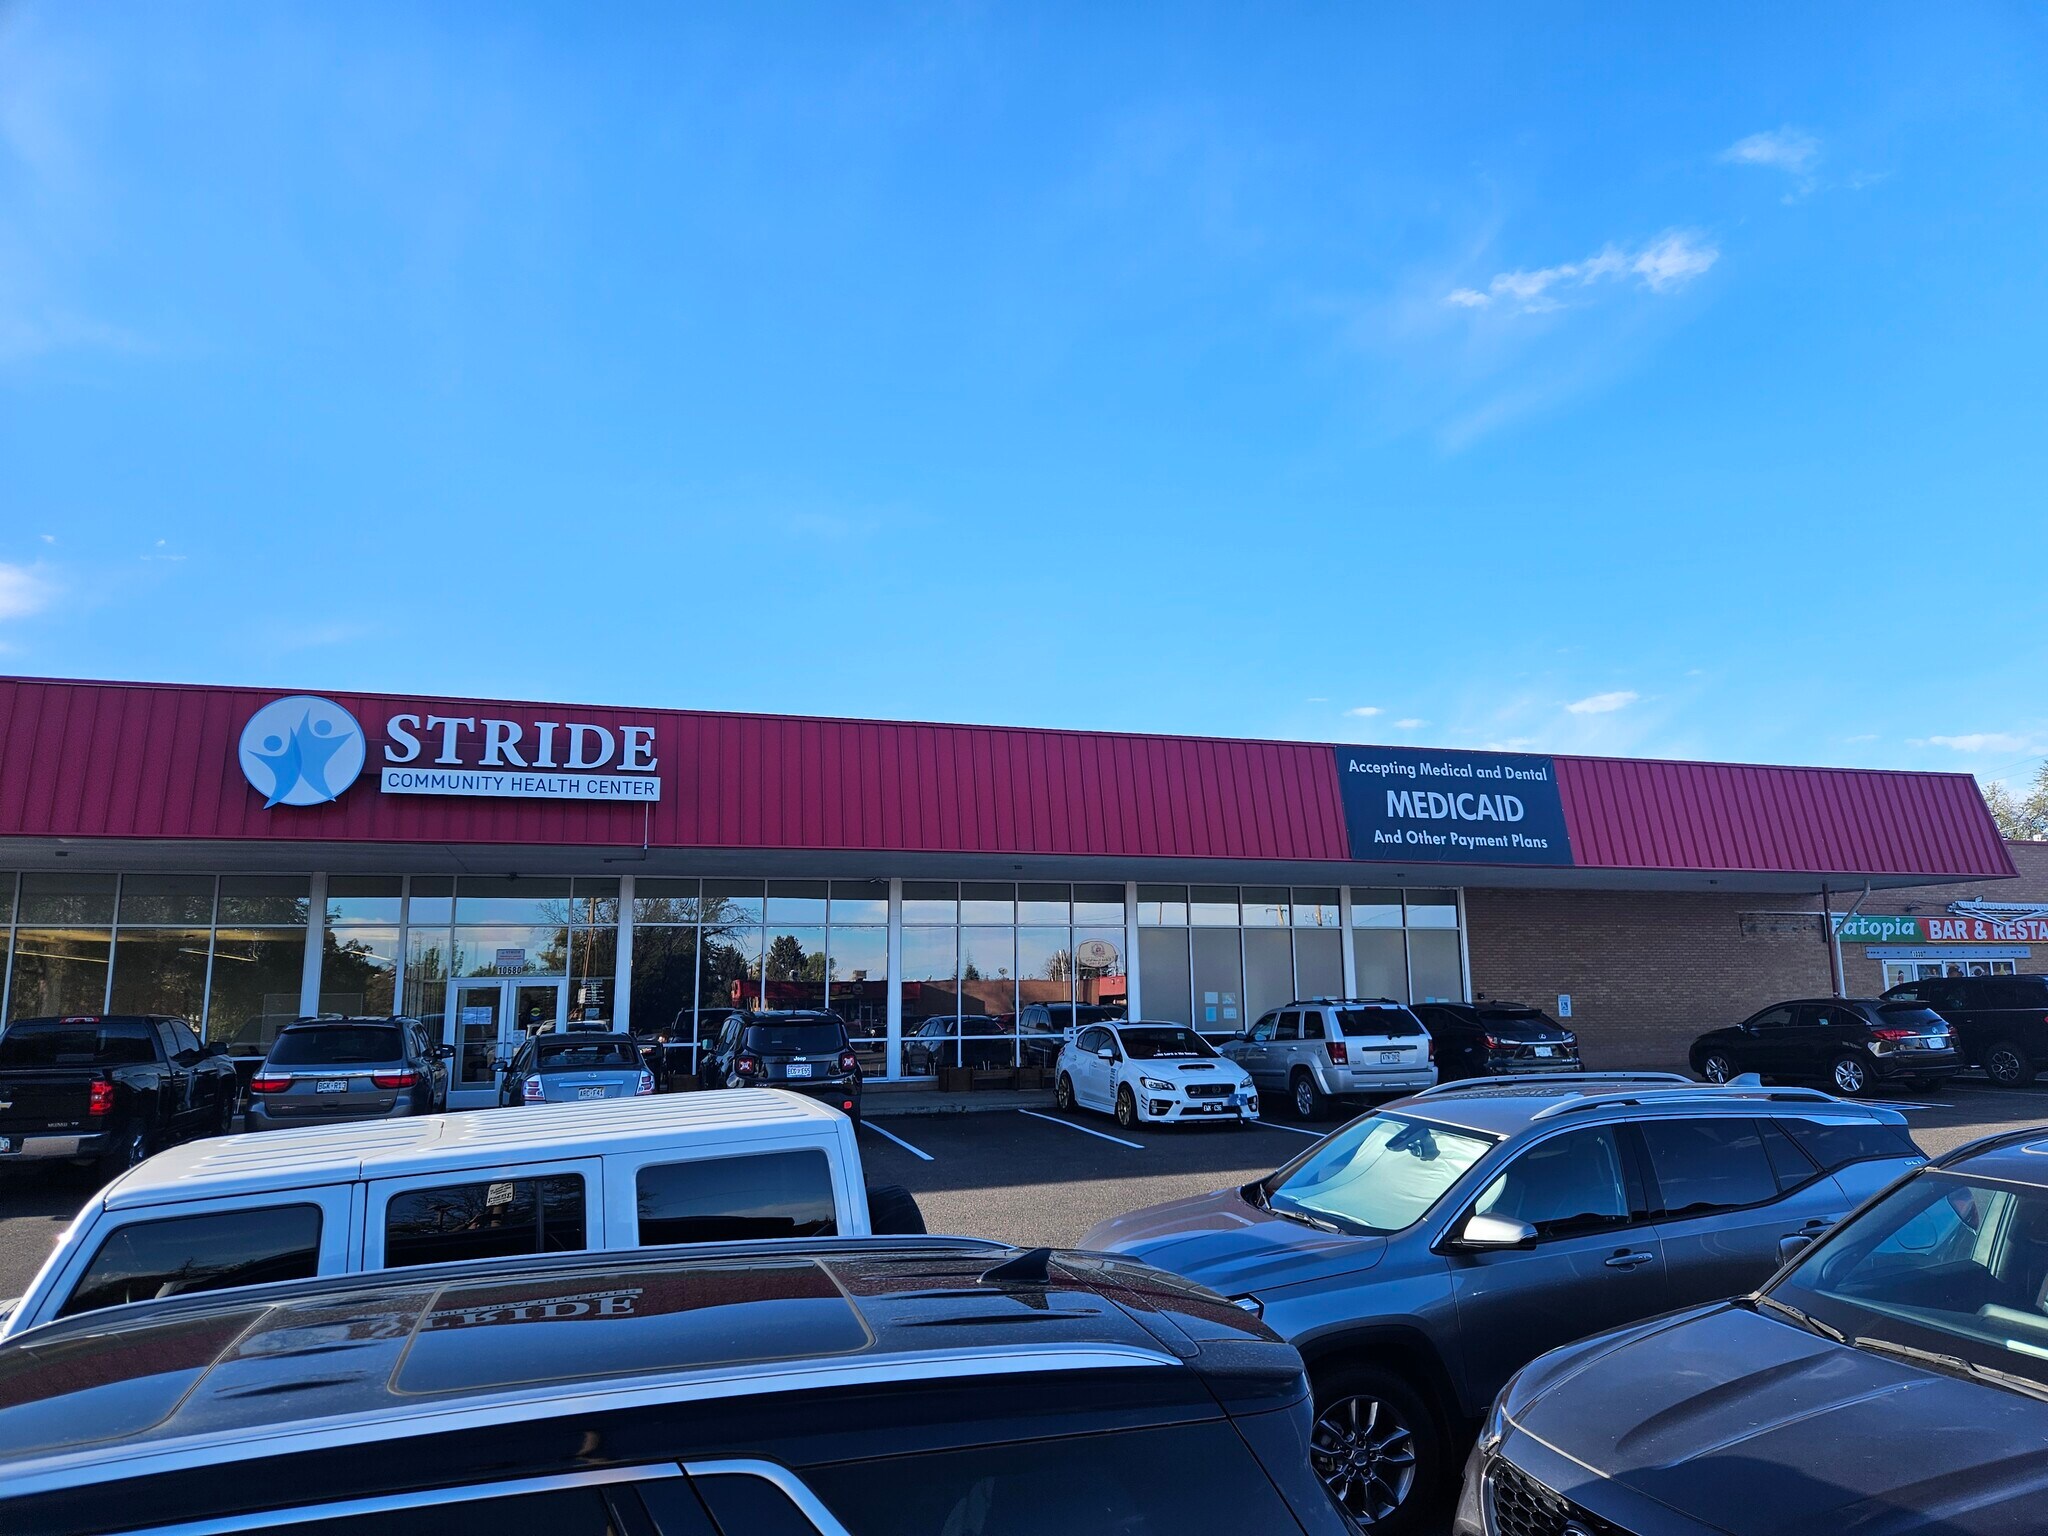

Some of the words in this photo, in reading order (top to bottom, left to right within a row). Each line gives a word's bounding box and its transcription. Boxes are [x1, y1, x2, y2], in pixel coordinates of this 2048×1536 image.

[384, 714, 658, 771] STRIDE
[1349, 759, 1416, 779] Accepting
[1420, 762, 1473, 778] Medical
[1476, 766, 1502, 779] and
[1505, 767, 1547, 781] Dental
[388, 773, 504, 791] COMMUNITY
[511, 777, 580, 793] HEALTH
[587, 780, 655, 795] CENTER
[1387, 790, 1524, 822] MEDICAID
[1374, 830, 1402, 844] And
[1406, 831, 1446, 846] Other
[1451, 833, 1508, 849] Payment
[1512, 834, 1548, 848] Plans
[1929, 920, 1968, 940] BAR
[1974, 920, 1987, 940] &
[498, 966, 522, 975] 10680
